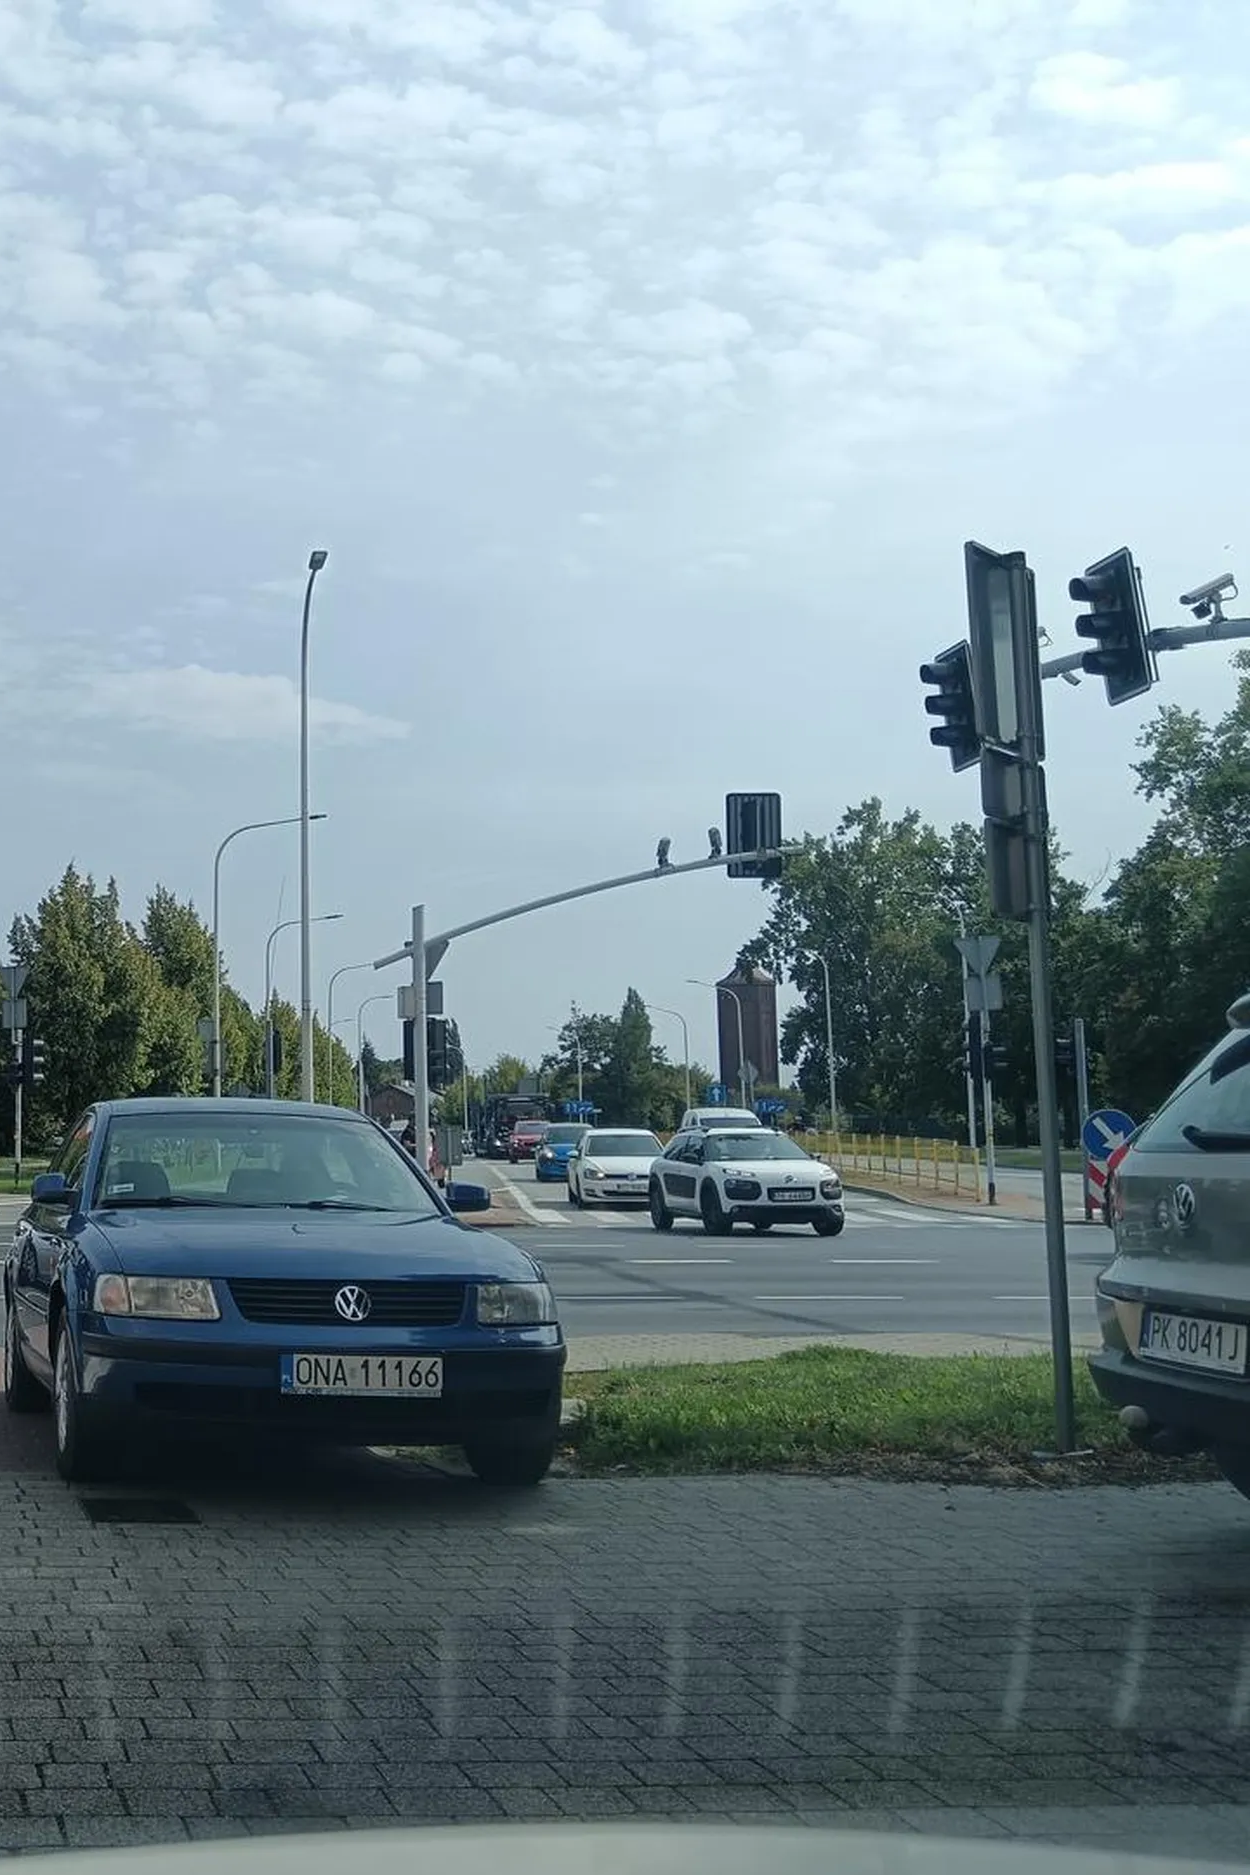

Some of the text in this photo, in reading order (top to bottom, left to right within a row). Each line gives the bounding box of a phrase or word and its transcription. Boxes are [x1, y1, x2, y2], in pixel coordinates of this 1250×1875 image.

[1151, 1315, 1239, 1361] PK 8041J
[296, 1357, 440, 1388] ONA 11166
